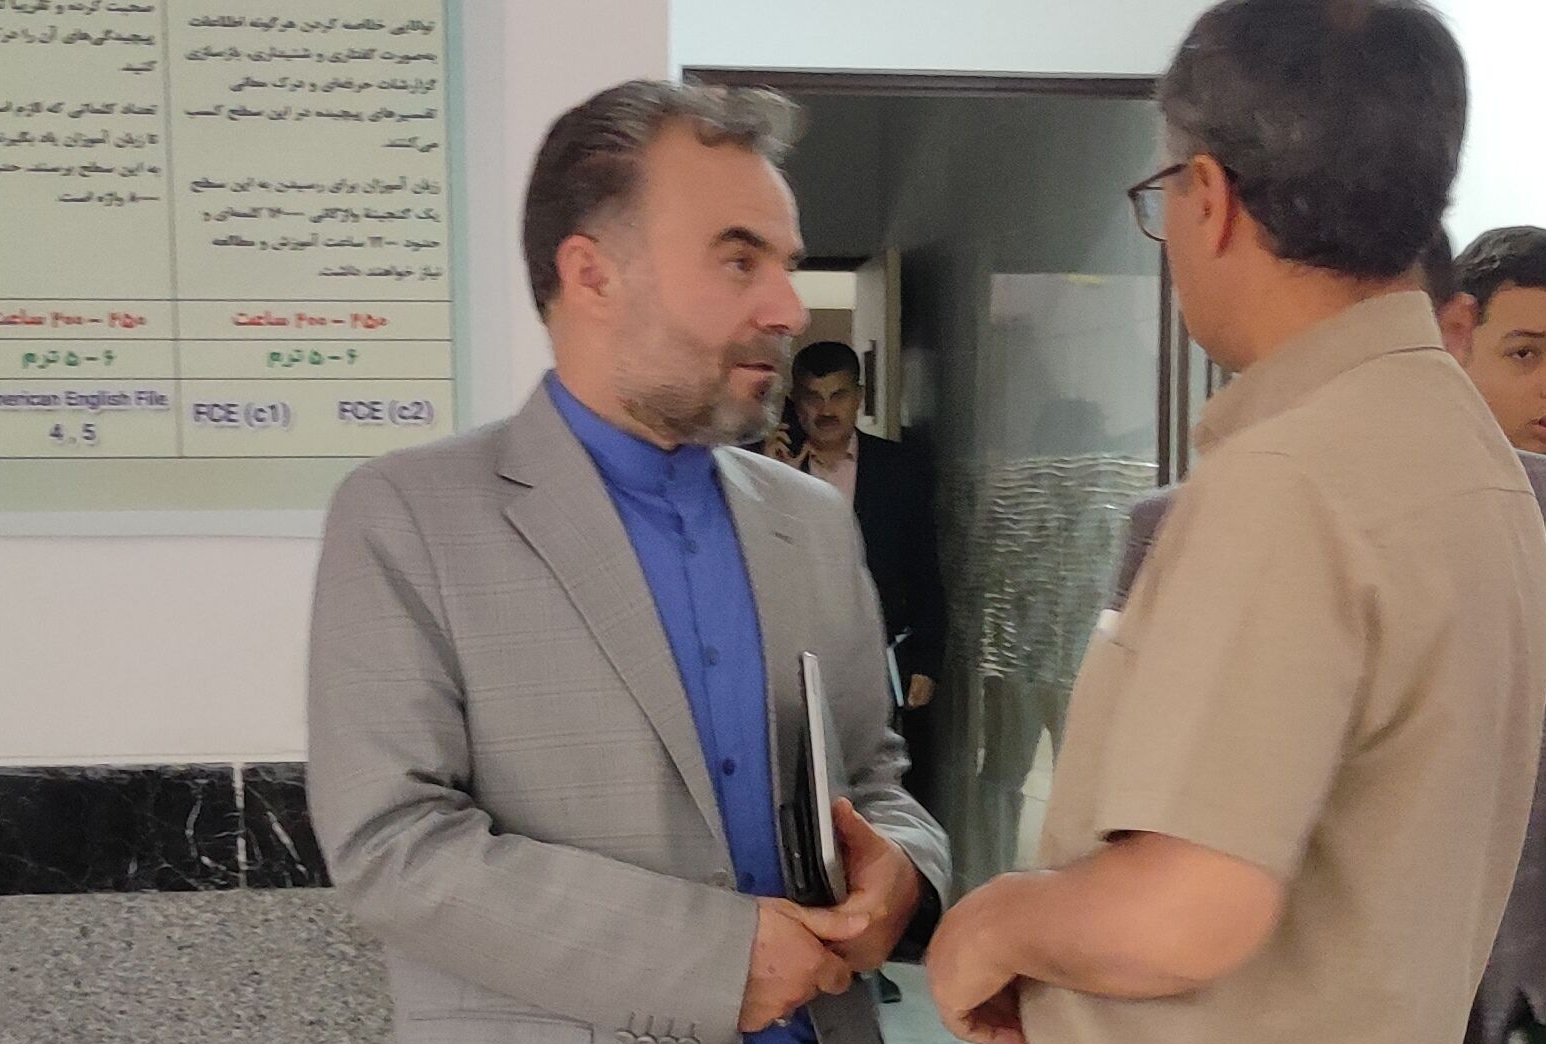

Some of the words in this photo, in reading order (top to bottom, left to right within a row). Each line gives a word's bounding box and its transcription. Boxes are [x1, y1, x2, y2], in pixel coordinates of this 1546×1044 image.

[64, 391, 131, 409] English
[134, 391, 169, 406] File
[339, 401, 383, 420] FCE
[388, 400, 434, 424] (c2)
[193, 403, 239, 422] FCE
[244, 402, 291, 427] (c1)
